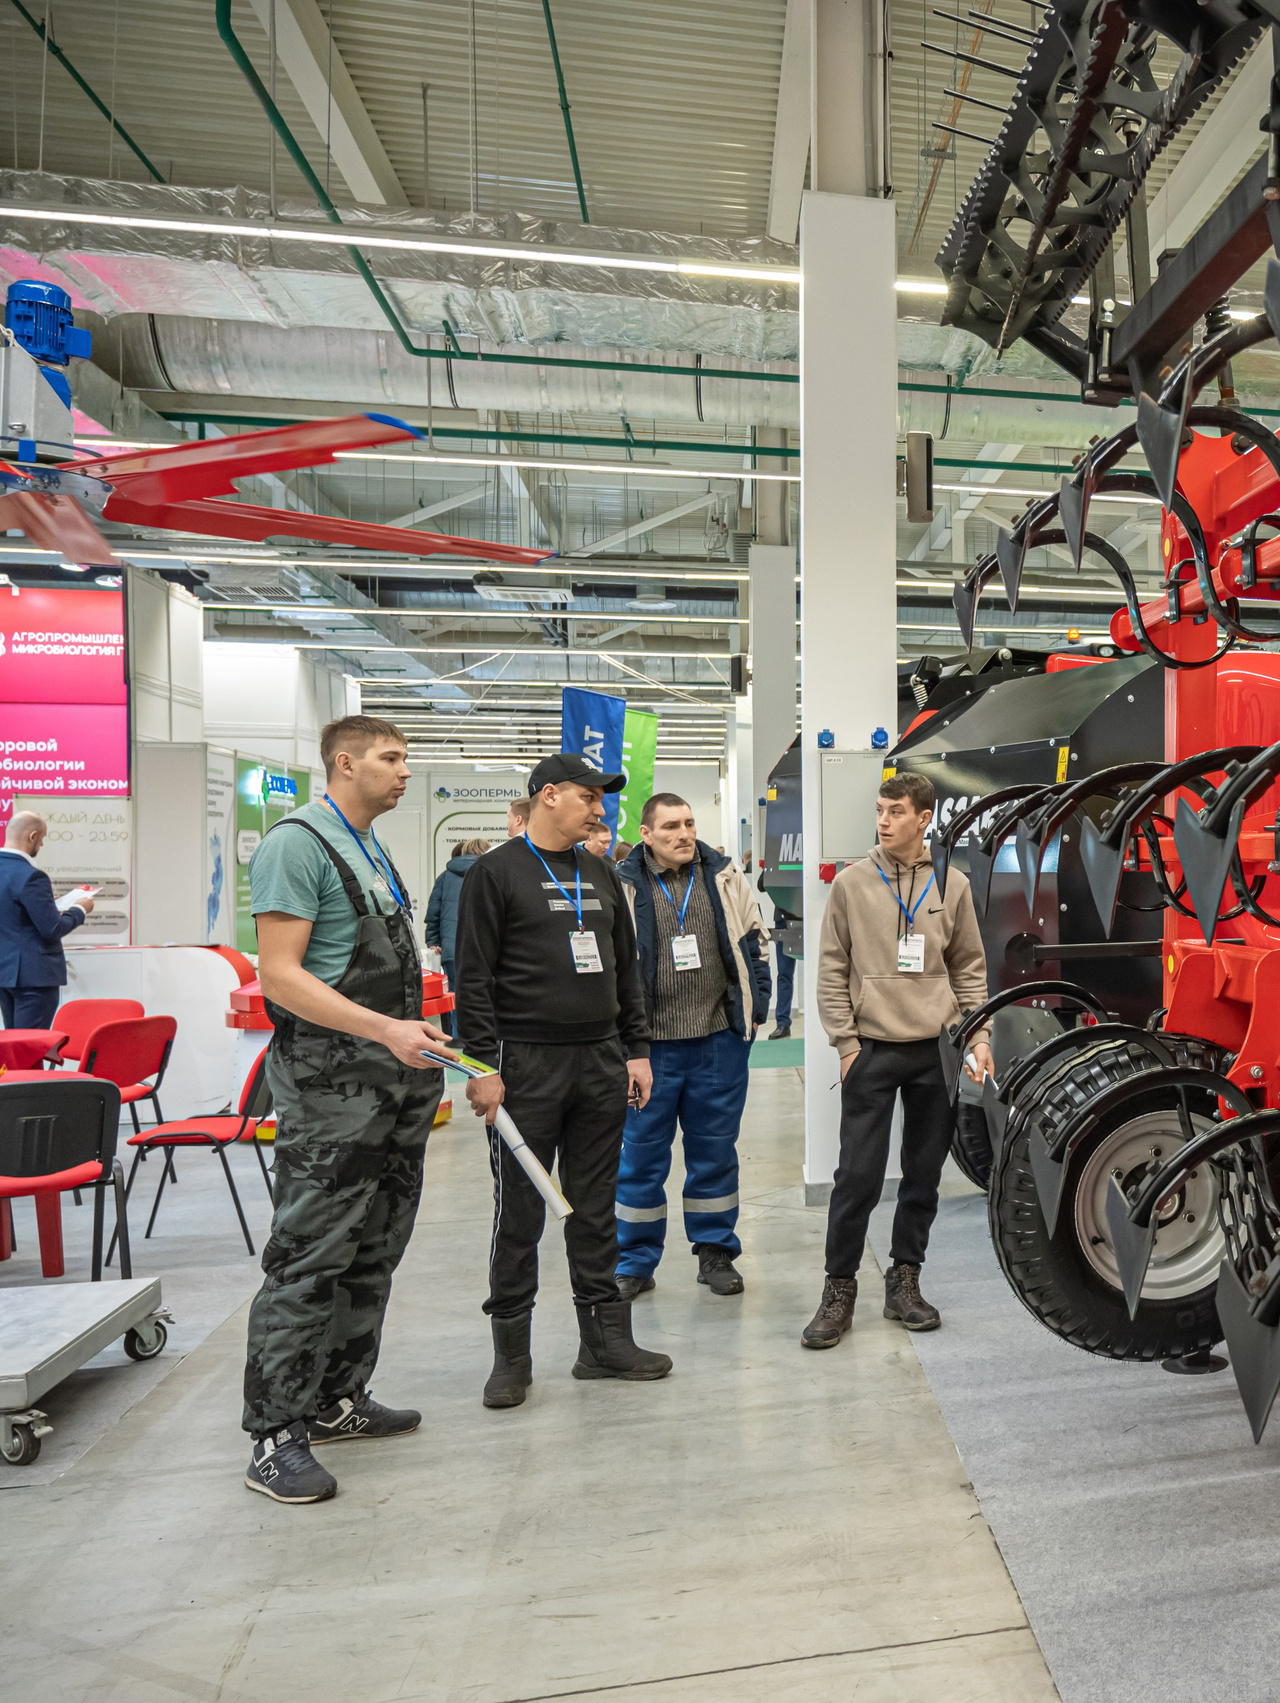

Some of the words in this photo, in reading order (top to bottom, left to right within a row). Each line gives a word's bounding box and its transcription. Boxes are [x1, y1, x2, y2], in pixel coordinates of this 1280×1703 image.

[12, 644, 115, 656] МИКРОБИОЛОГИЯ
[0, 758, 85, 771] биологии
[0, 777, 64, 790] йчивой
[453, 788, 522, 798] ЗООПЕРМЬ
[92, 813, 126, 825] ДЕНЬ
